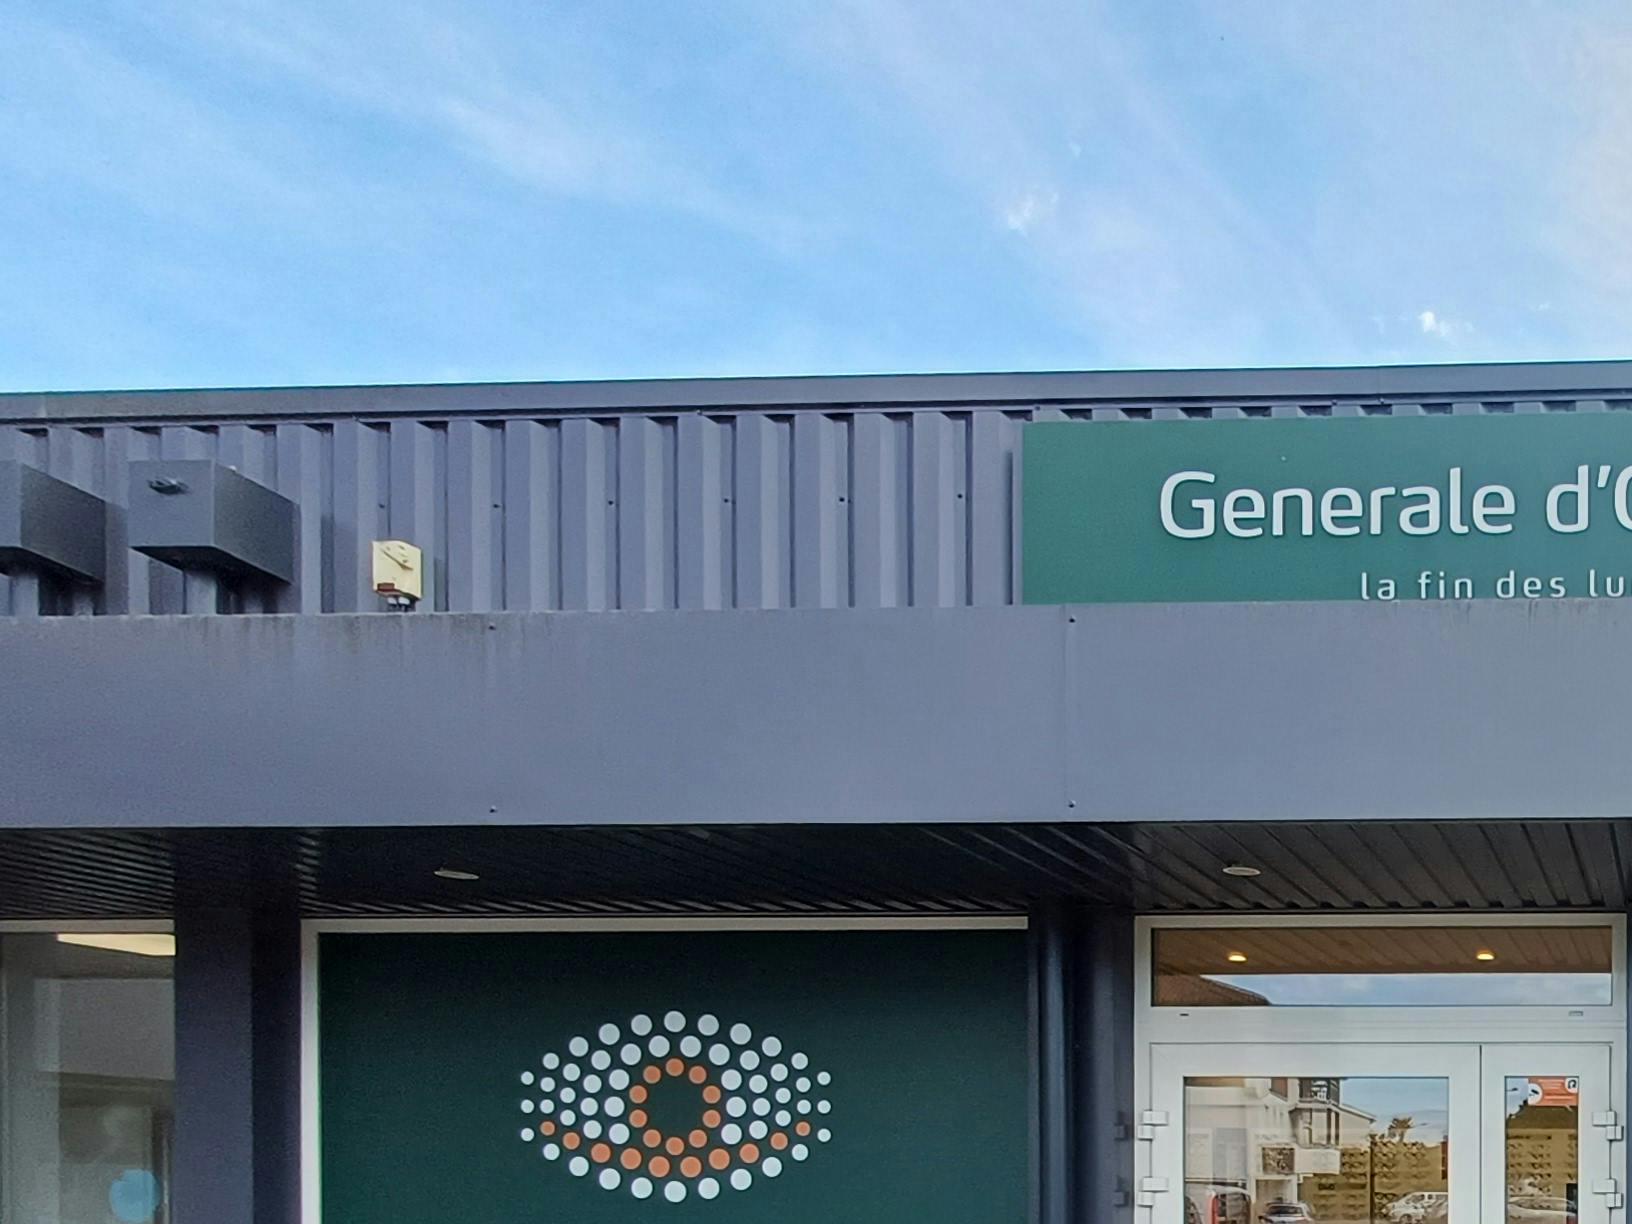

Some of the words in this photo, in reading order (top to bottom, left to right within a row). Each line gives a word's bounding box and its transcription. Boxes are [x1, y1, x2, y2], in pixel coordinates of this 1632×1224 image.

[1159, 467, 1516, 539] Generale
[1360, 572, 1397, 600] la
[1417, 570, 1474, 599] fin
[1495, 569, 1567, 599] des
